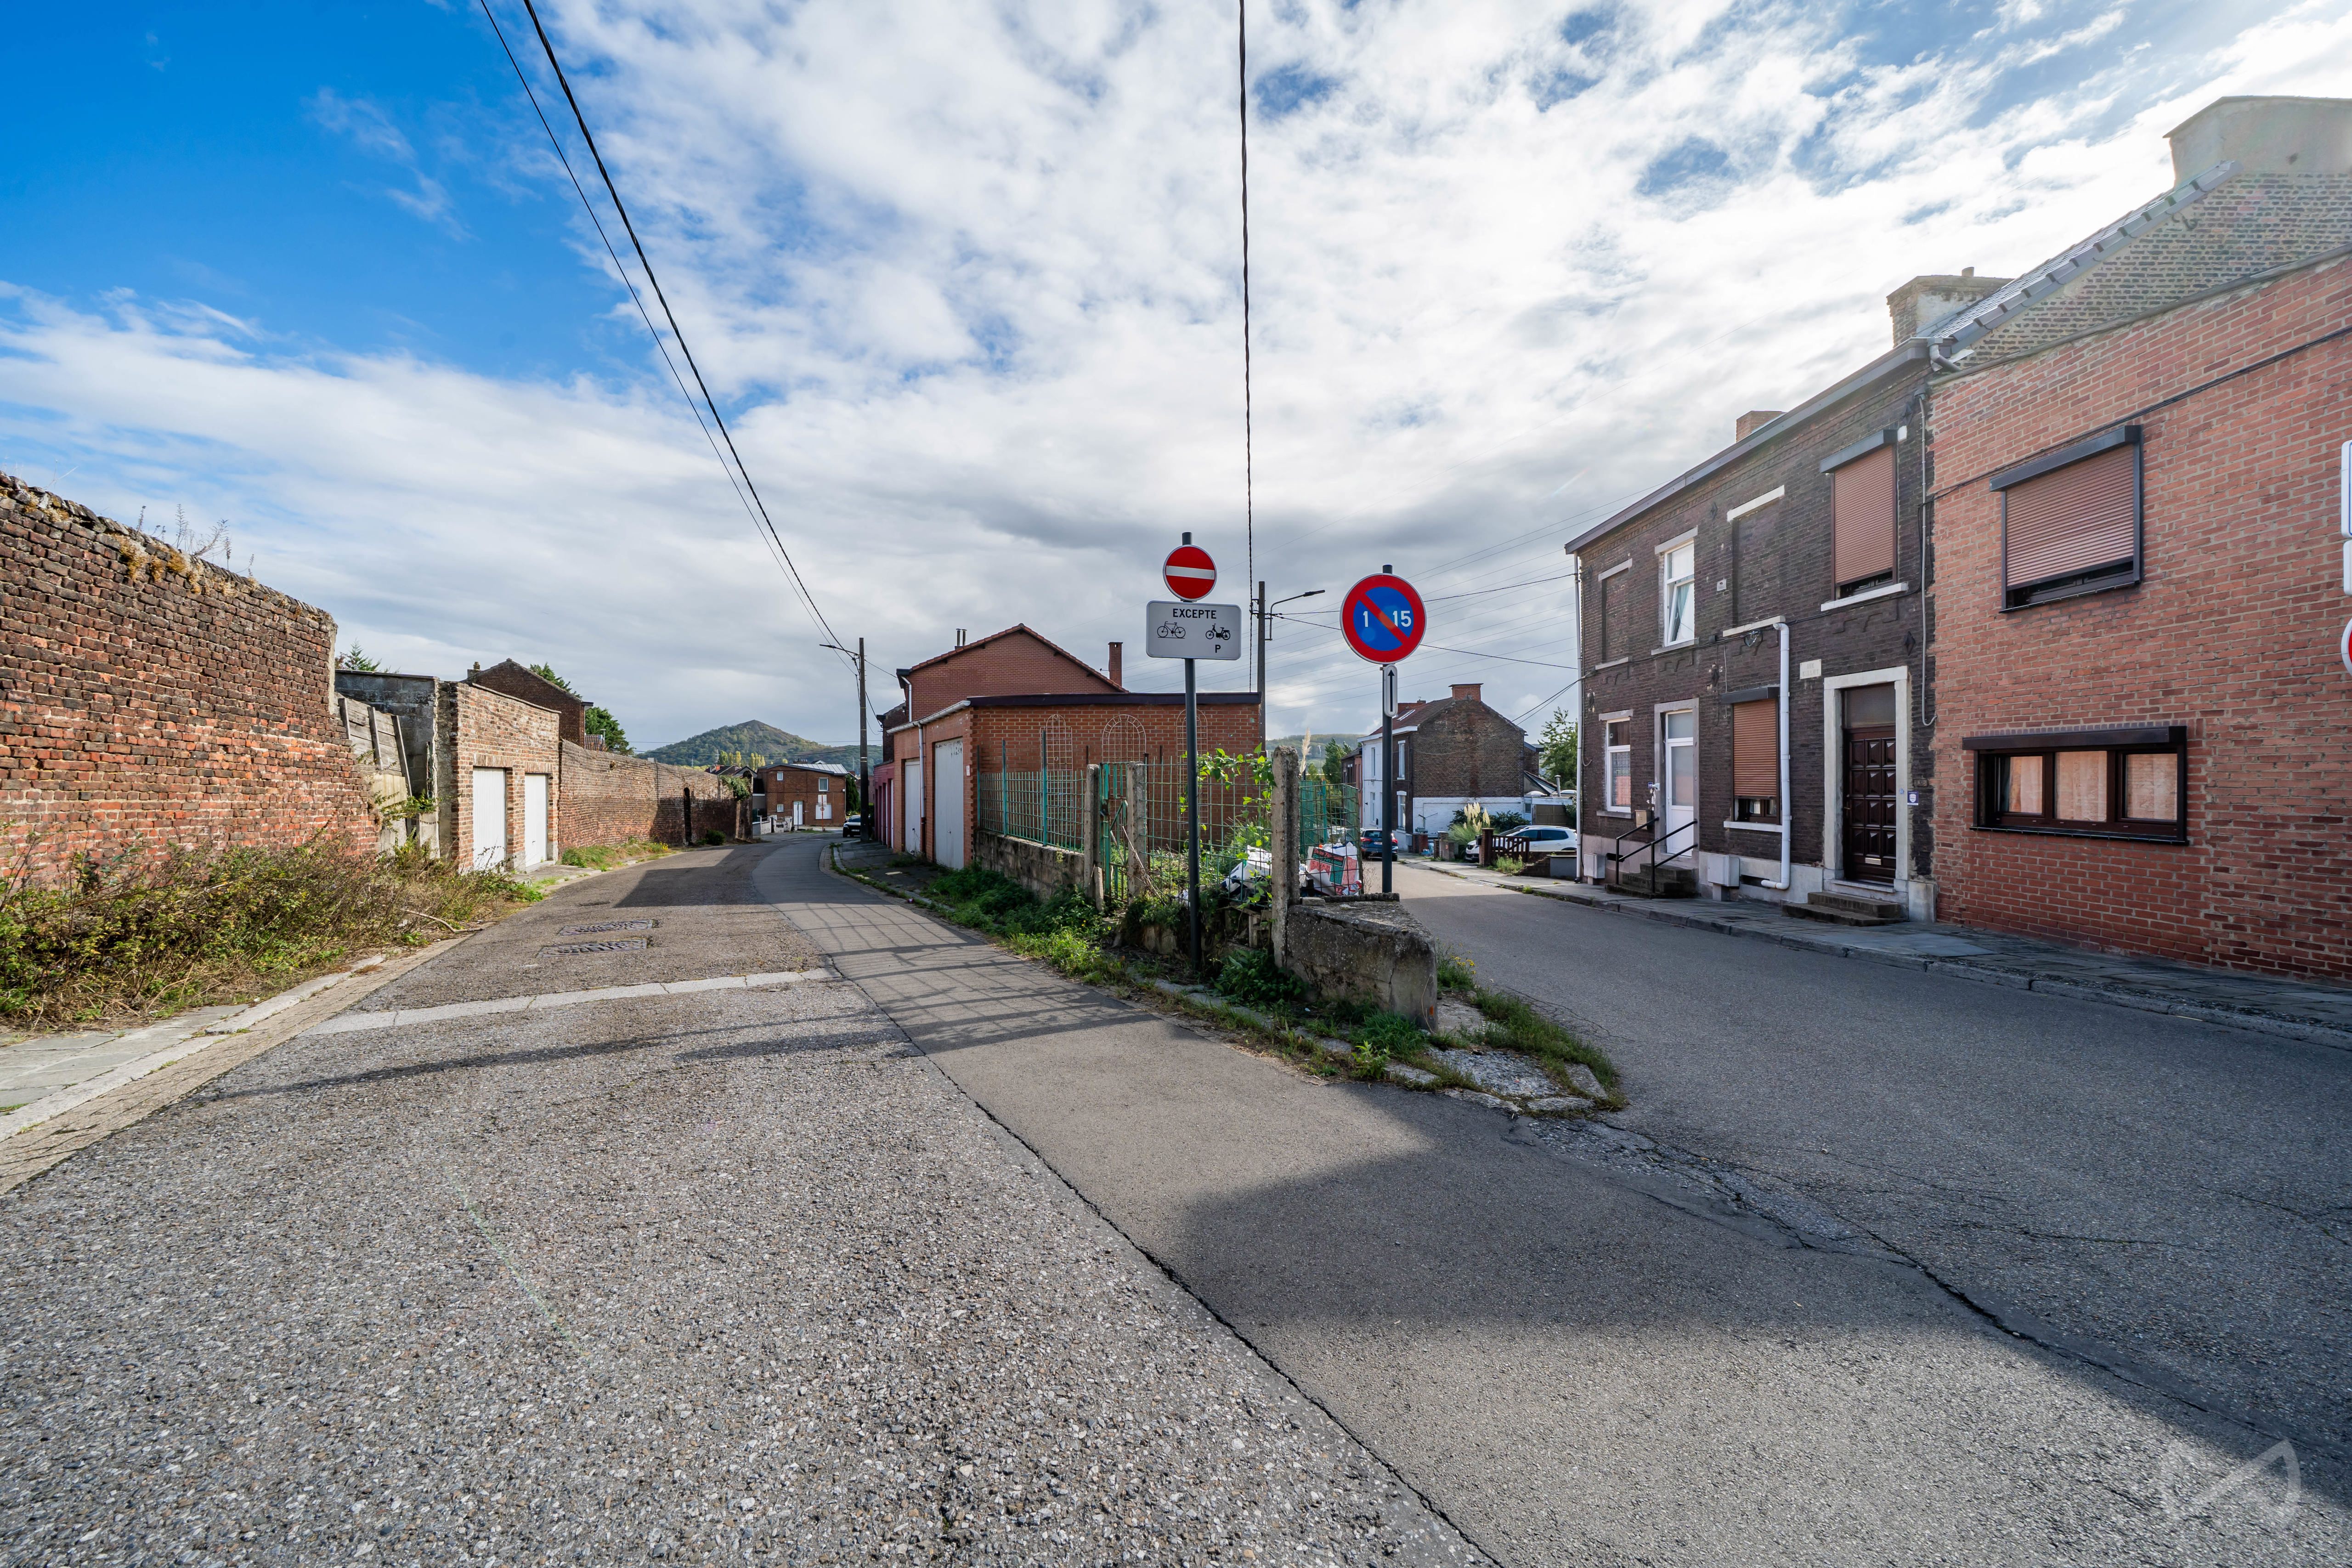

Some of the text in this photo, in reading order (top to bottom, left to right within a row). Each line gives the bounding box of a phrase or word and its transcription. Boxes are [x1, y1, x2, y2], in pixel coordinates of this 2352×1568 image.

[1173, 608, 1216, 619] EXCEPTE
[1363, 611, 1412, 627] 1 15
[1215, 645, 1221, 653] P
